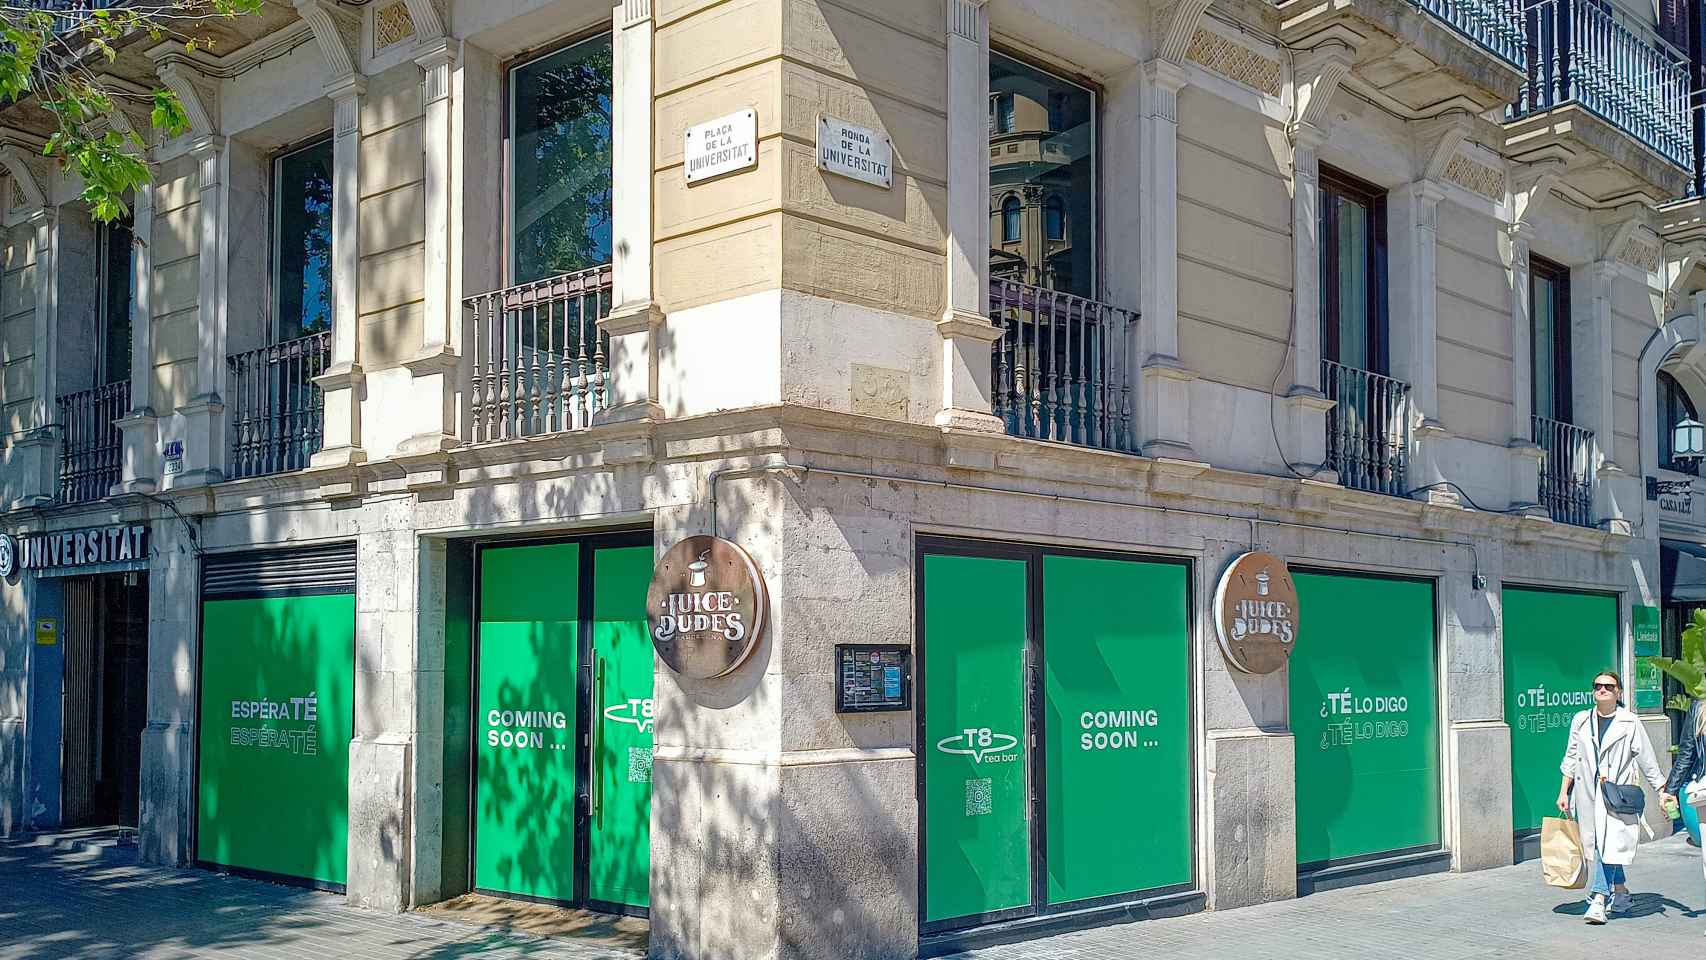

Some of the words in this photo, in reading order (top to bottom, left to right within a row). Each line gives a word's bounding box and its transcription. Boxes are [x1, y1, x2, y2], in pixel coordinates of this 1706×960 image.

[705, 140, 718, 151] DE
[720, 135, 732, 147] LA
[841, 128, 870, 145] RONDA
[690, 143, 749, 172] UNIVERSITAT
[841, 140, 853, 151] DE
[859, 145, 871, 157] LA
[822, 147, 888, 177] UNIVERSITAT
[1660, 498, 1678, 513] CASA
[19, 525, 145, 569] UNIVERSITAT
[669, 592, 732, 616] JUICE
[1240, 600, 1287, 620] JUICE
[655, 613, 745, 641] DUDES
[1231, 618, 1294, 643] DUDES
[231, 691, 317, 721] ESPÉRATÉ
[1355, 697, 1373, 714] LO
[1375, 697, 1408, 713] DIGO
[1518, 693, 1527, 708] O
[1527, 683, 1545, 707] TÉ
[1547, 693, 1560, 706] LO
[487, 709, 567, 729] COMING
[1080, 709, 1158, 729] COMING
[1527, 708, 1546, 733] TÉ
[230, 724, 317, 756] ESPÉRATÉ
[487, 730, 543, 749] SOON
[963, 727, 993, 748] T8
[1081, 730, 1138, 751] SOON
[1355, 722, 1374, 740] LO
[1375, 720, 1409, 738] DIGO
[984, 754, 1001, 764] tea
[1002, 752, 1018, 763] bar
